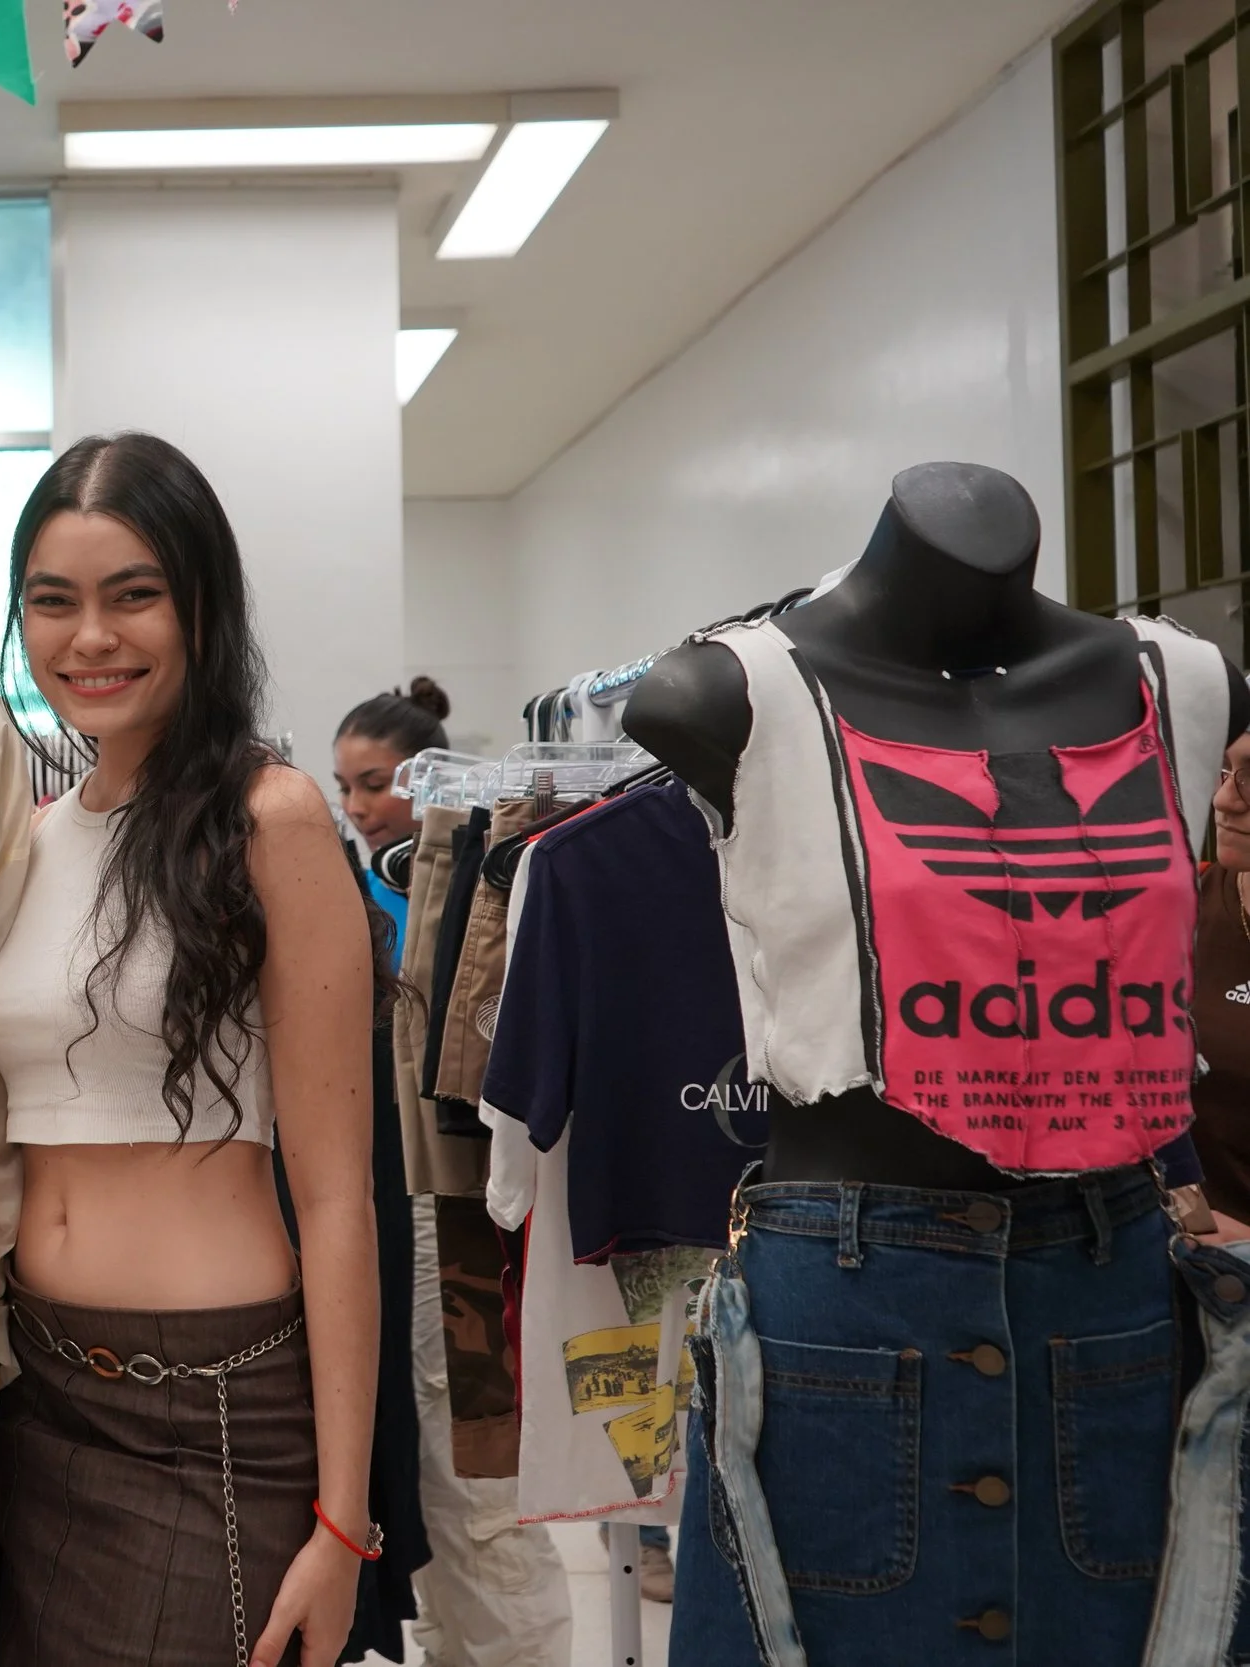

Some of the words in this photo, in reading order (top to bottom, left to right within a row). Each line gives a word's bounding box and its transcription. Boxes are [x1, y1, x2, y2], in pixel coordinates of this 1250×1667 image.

[914, 1070, 943, 1085] DIE
[957, 1070, 1019, 1085] MARKE
[1063, 1071, 1100, 1085] DEN
[1114, 1070, 1124, 1084] 3
[913, 1092, 949, 1108] THE
[1079, 1092, 1112, 1107] THE
[1049, 1116, 1087, 1131] AUX
[1114, 1114, 1125, 1130] 3
